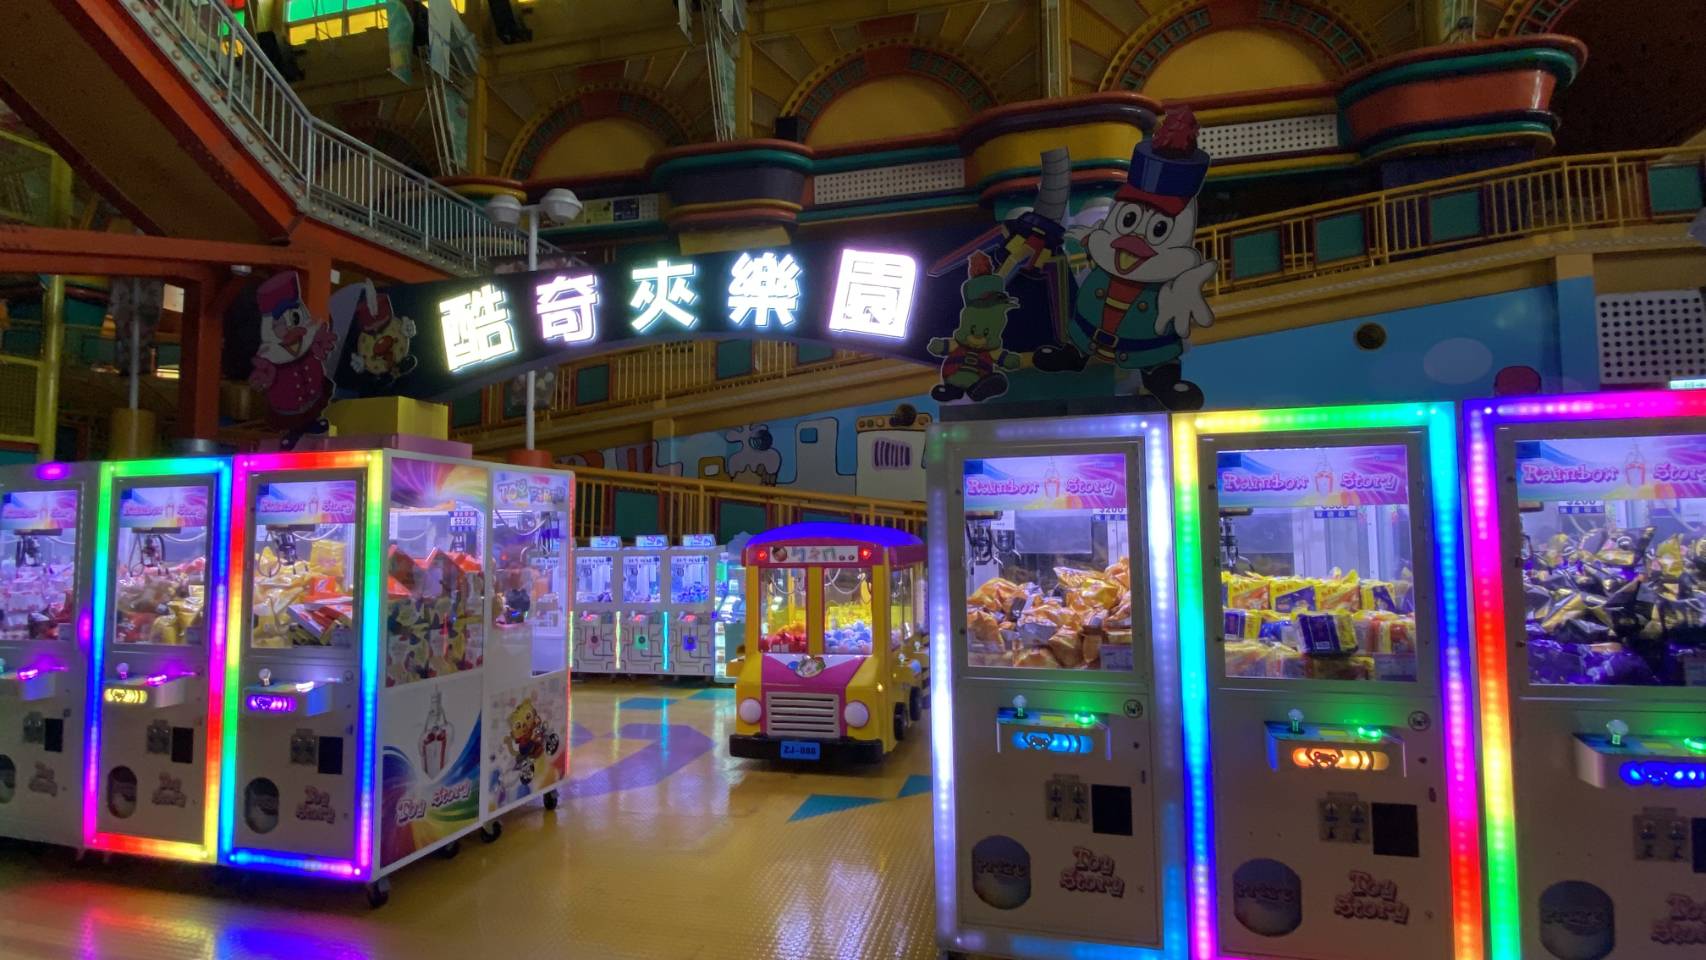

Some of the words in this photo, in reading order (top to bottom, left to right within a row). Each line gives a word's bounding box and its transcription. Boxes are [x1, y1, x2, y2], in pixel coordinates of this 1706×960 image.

[438, 249, 919, 372] 酷奇夾樂園
[967, 478, 1040, 496] Rainbow
[1065, 476, 1116, 496] Story
[1222, 471, 1309, 493] Rainbow
[1340, 470, 1399, 492] Story
[1523, 463, 1620, 485] Rainbow
[397, 798, 427, 824] Toy
[431, 780, 471, 808] Story
[1072, 846, 1115, 878] Toy
[1060, 868, 1126, 899] Story
[1350, 869, 1398, 903] Toy
[1333, 894, 1411, 926] Story
